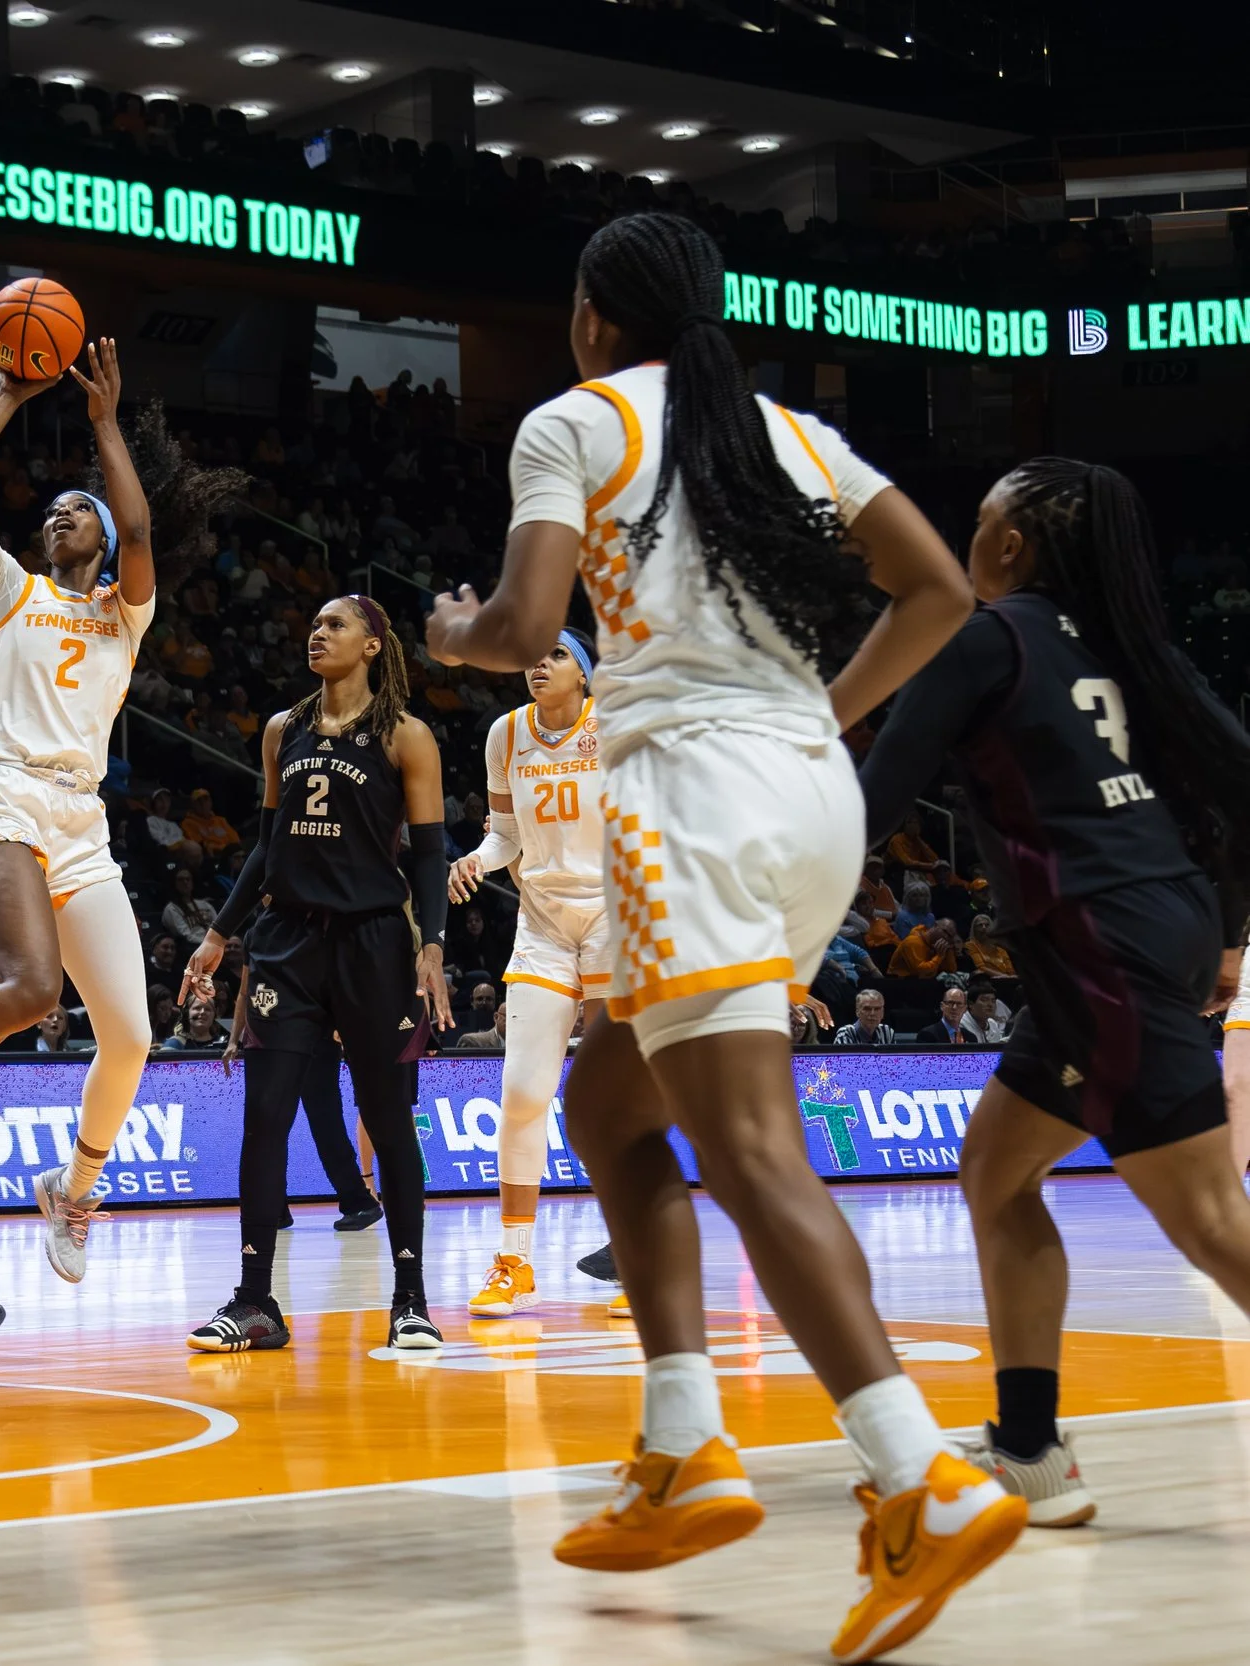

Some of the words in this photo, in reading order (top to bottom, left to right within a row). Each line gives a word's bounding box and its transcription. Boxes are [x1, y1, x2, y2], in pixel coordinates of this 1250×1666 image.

[244, 198, 361, 266] TODAY
[785, 281, 818, 332] OF
[824, 286, 982, 355] SOMETHING
[987, 309, 1048, 358] BIG
[1127, 298, 1250, 351] LEARN
[25, 613, 120, 638] TENNESSEE
[55, 638, 87, 690] 2
[1070, 678, 1130, 766] 3
[330, 758, 368, 785] TEXAS
[517, 758, 598, 778] TENNESSEE
[306, 774, 330, 816] 2
[533, 780, 580, 824] 20
[290, 820, 342, 837] AGGIES
